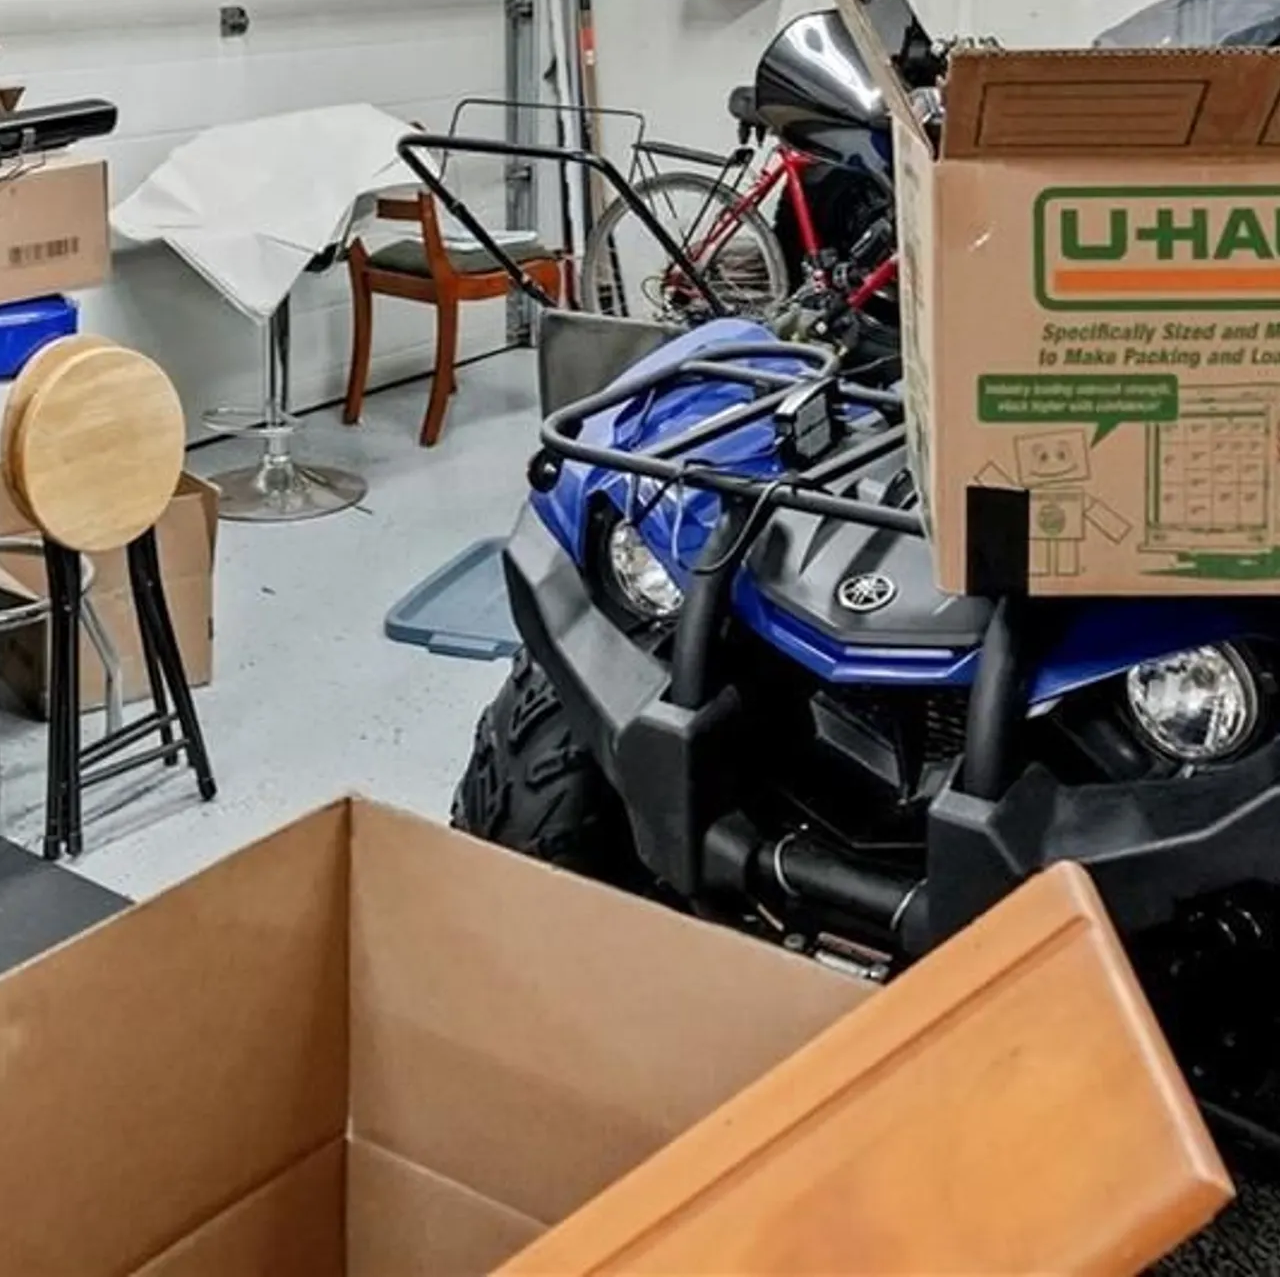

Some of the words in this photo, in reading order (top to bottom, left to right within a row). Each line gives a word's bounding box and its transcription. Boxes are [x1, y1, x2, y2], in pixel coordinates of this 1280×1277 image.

[1042, 322, 1156, 344] Specifically
[1163, 322, 1216, 341] Sized
[1221, 322, 1260, 340] and
[1039, 348, 1058, 366] to
[1063, 348, 1116, 365] Make
[1123, 347, 1201, 368] Packing
[1207, 347, 1245, 365] and
